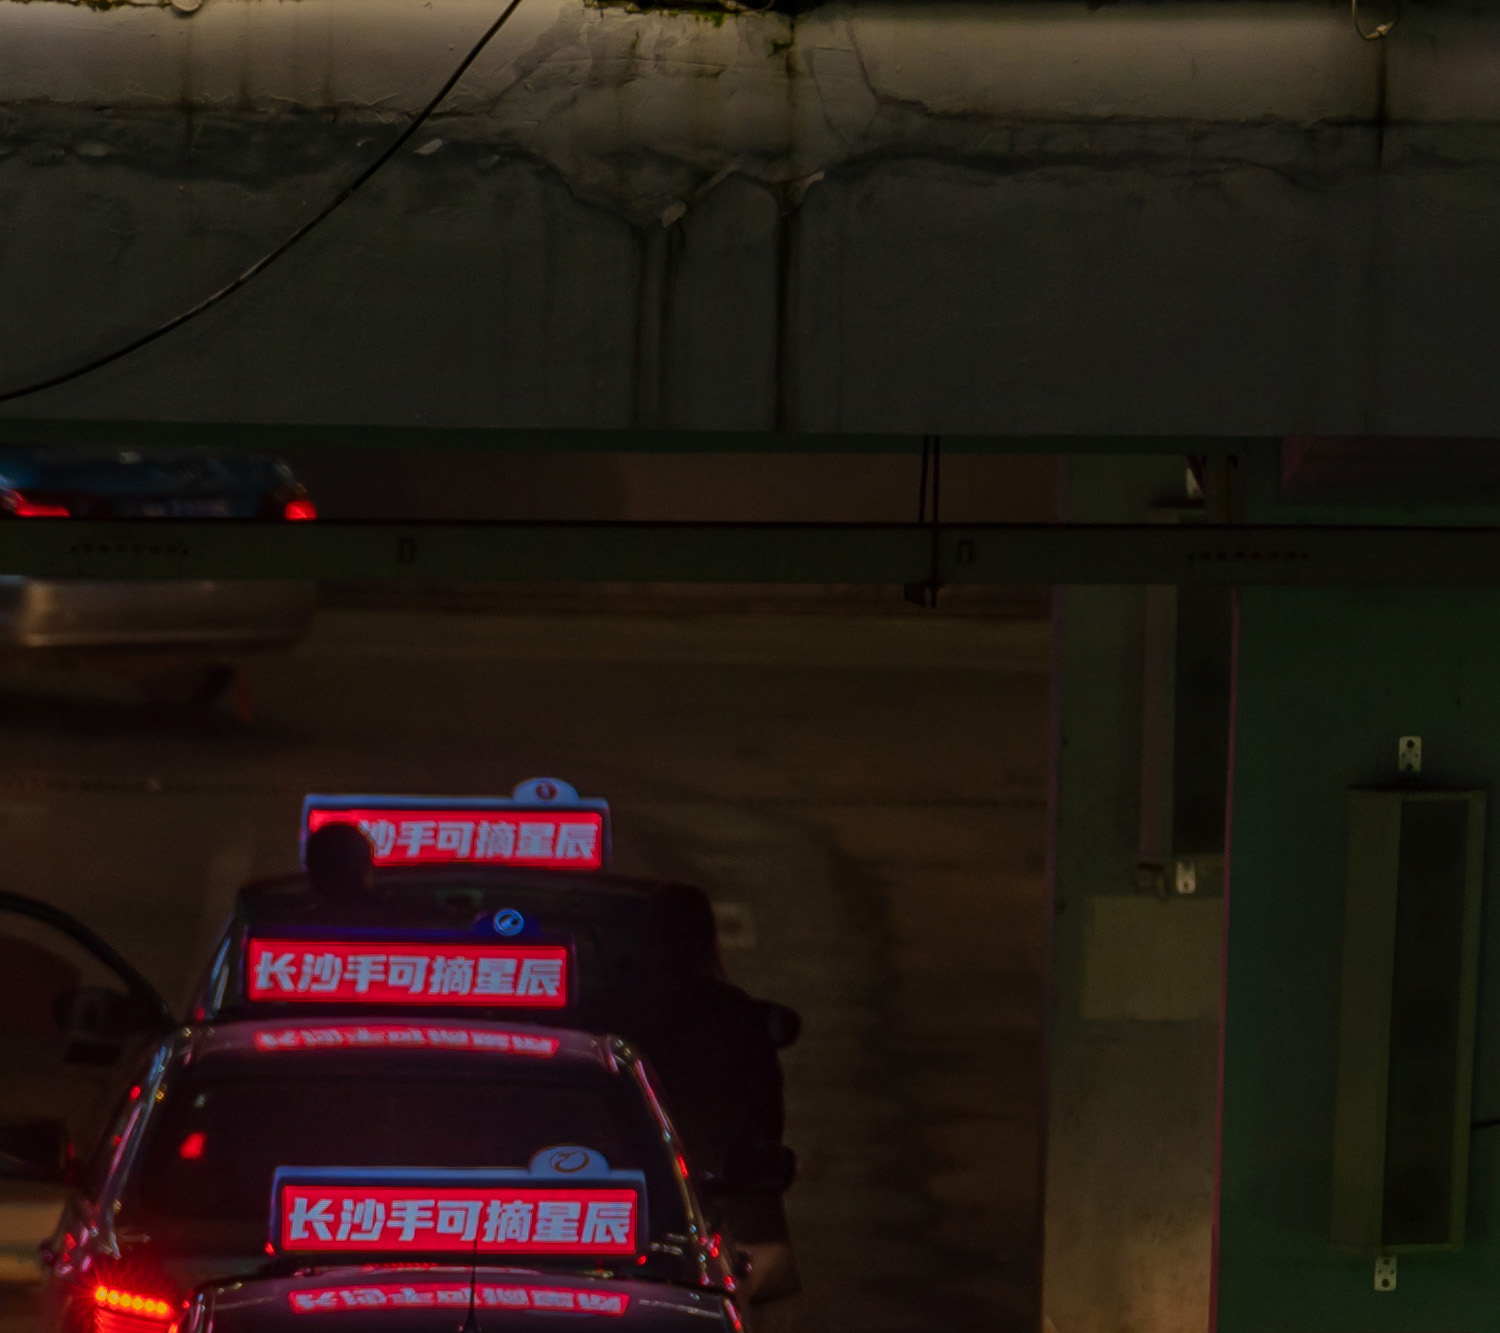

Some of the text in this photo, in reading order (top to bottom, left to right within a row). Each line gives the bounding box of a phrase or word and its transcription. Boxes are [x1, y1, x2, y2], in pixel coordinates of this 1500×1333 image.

[256, 952, 561, 996] 长沙手可摘星辰
[290, 1198, 631, 1243] 长沙手可摘星辰
